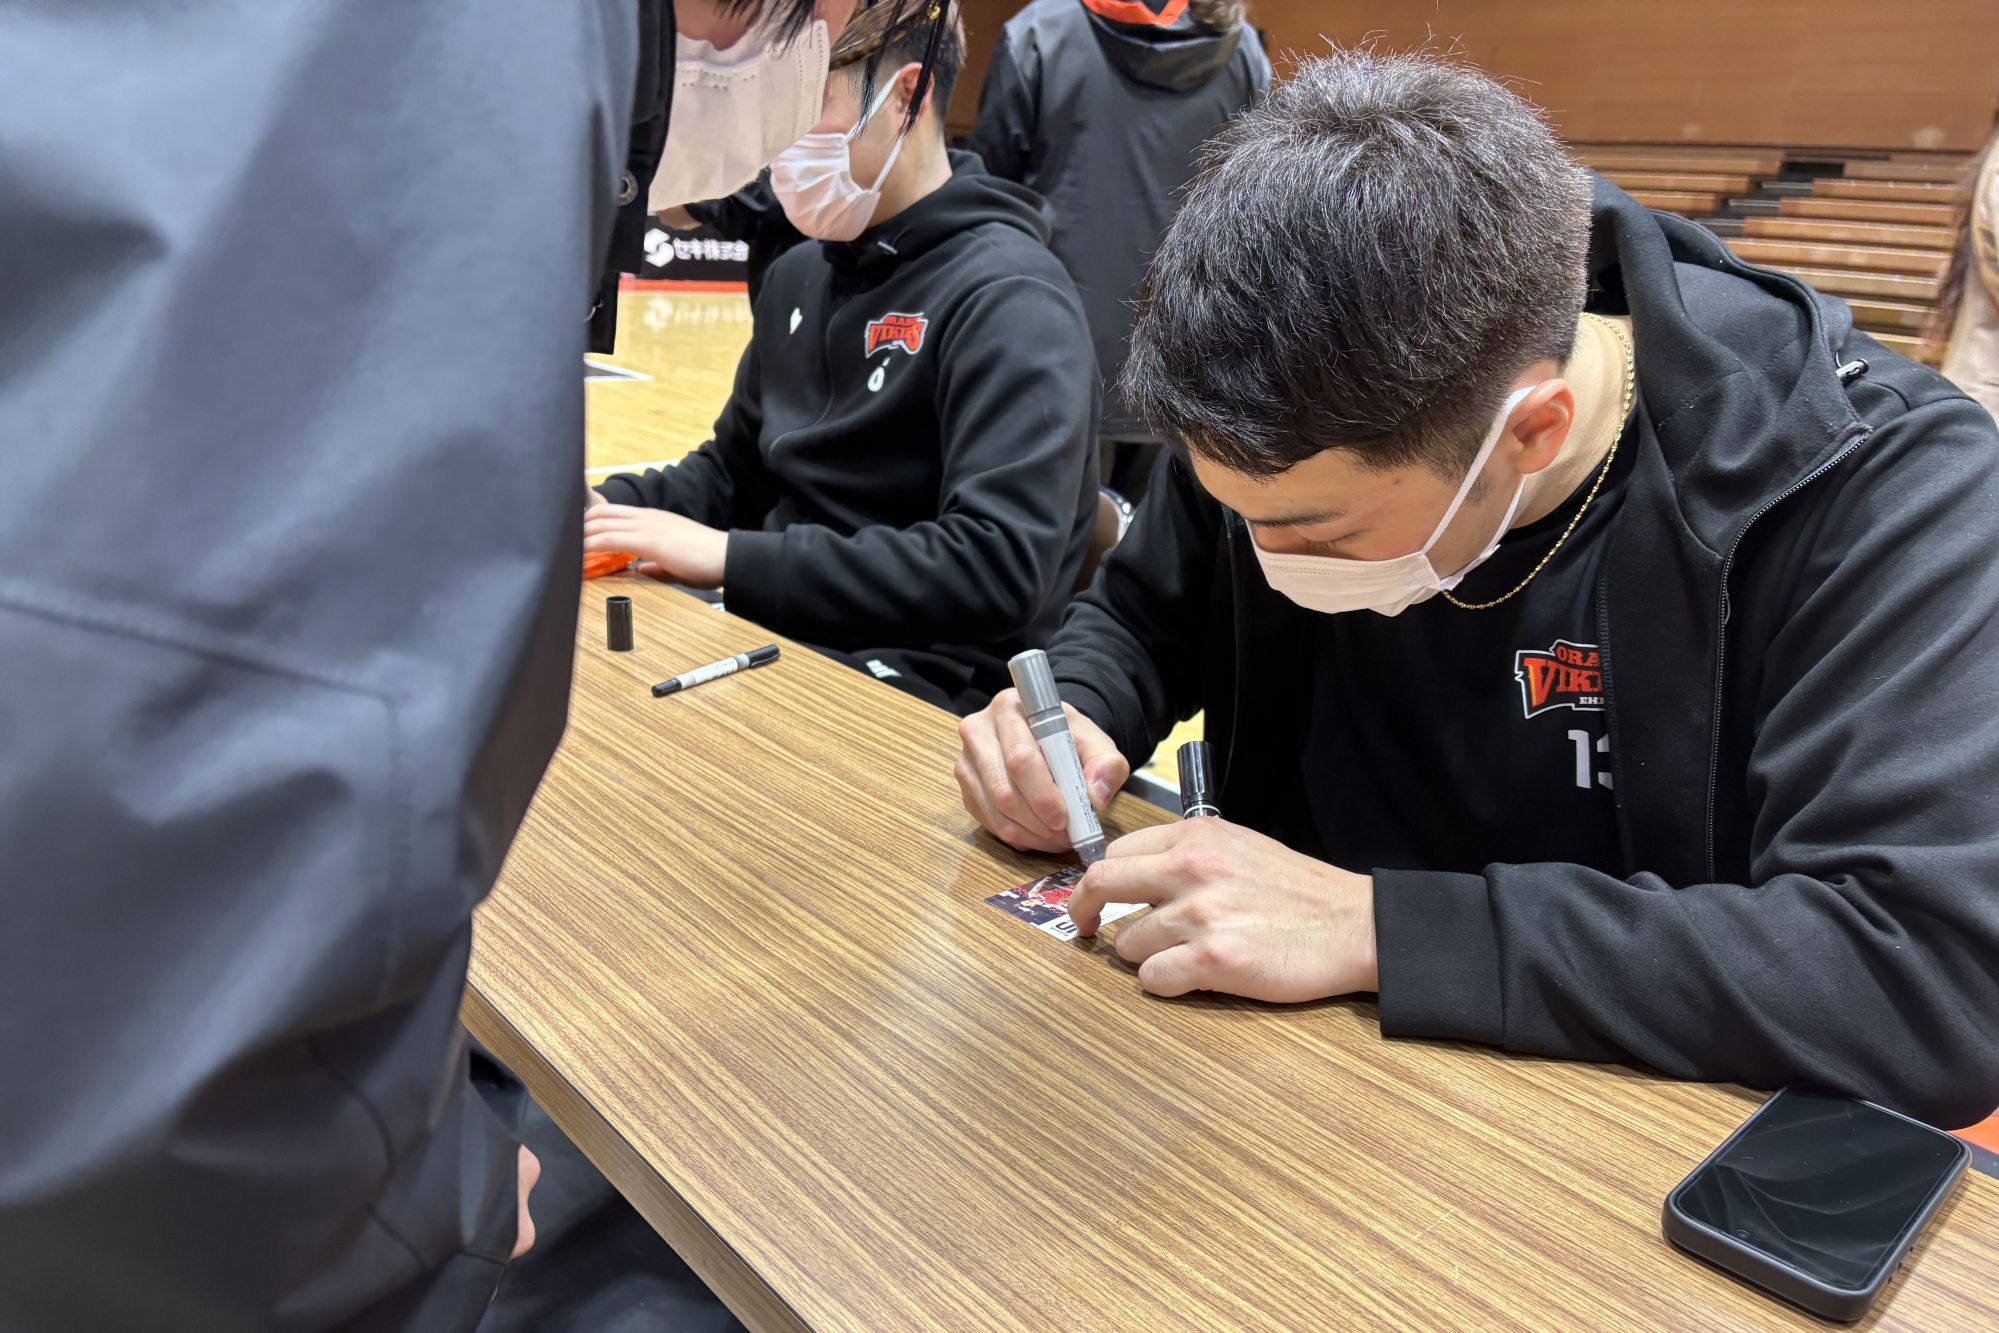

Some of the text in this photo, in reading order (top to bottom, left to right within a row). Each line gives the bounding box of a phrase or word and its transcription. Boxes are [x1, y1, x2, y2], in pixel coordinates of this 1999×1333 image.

[1555, 645, 1600, 667] ORA
[1523, 657, 1603, 708] VIKI
[1579, 696, 1604, 705] EHI
